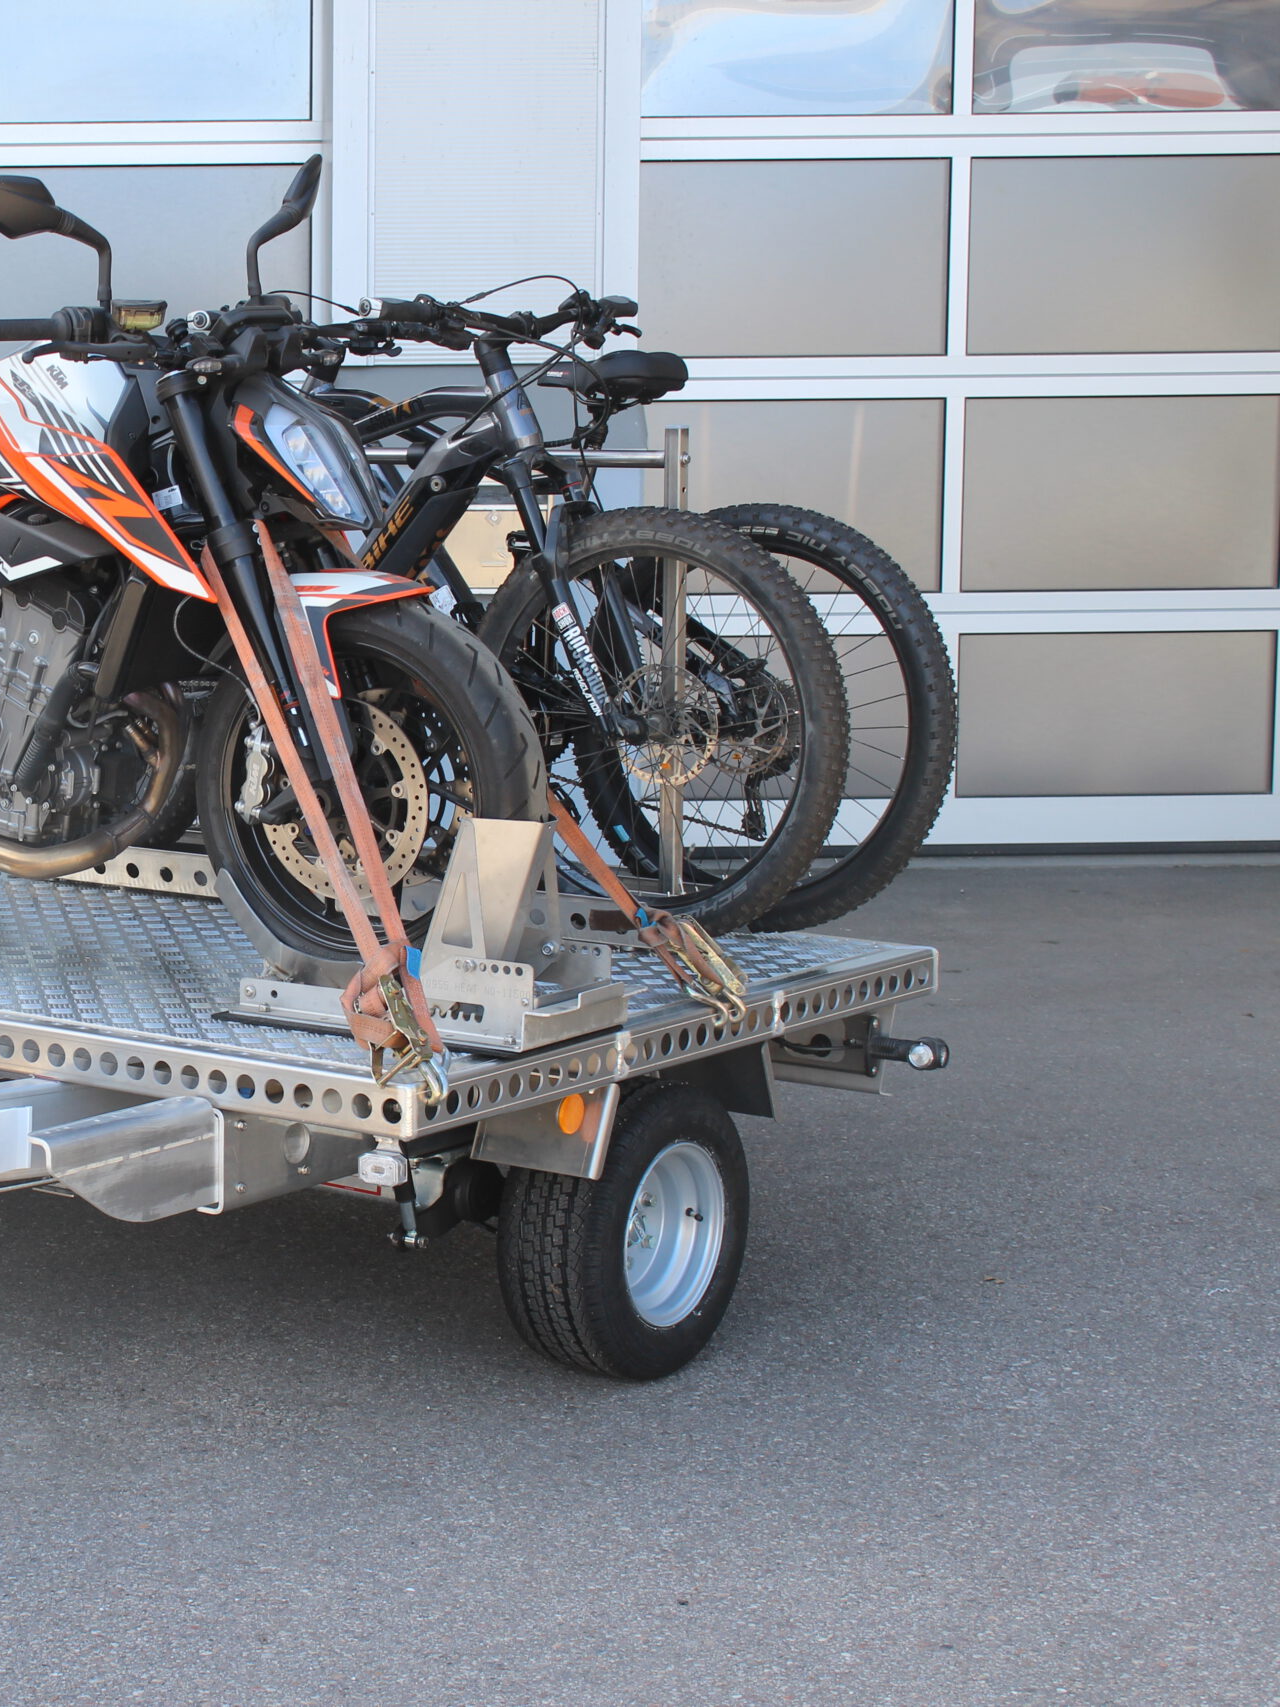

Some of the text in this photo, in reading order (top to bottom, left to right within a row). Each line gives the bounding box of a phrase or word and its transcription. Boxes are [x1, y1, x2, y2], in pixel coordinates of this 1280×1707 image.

[46, 364, 69, 390] KTM
[617, 529, 711, 560] NOBBY
[785, 530, 903, 630] NOBBY NIC
[572, 668, 604, 717] REVELATION
